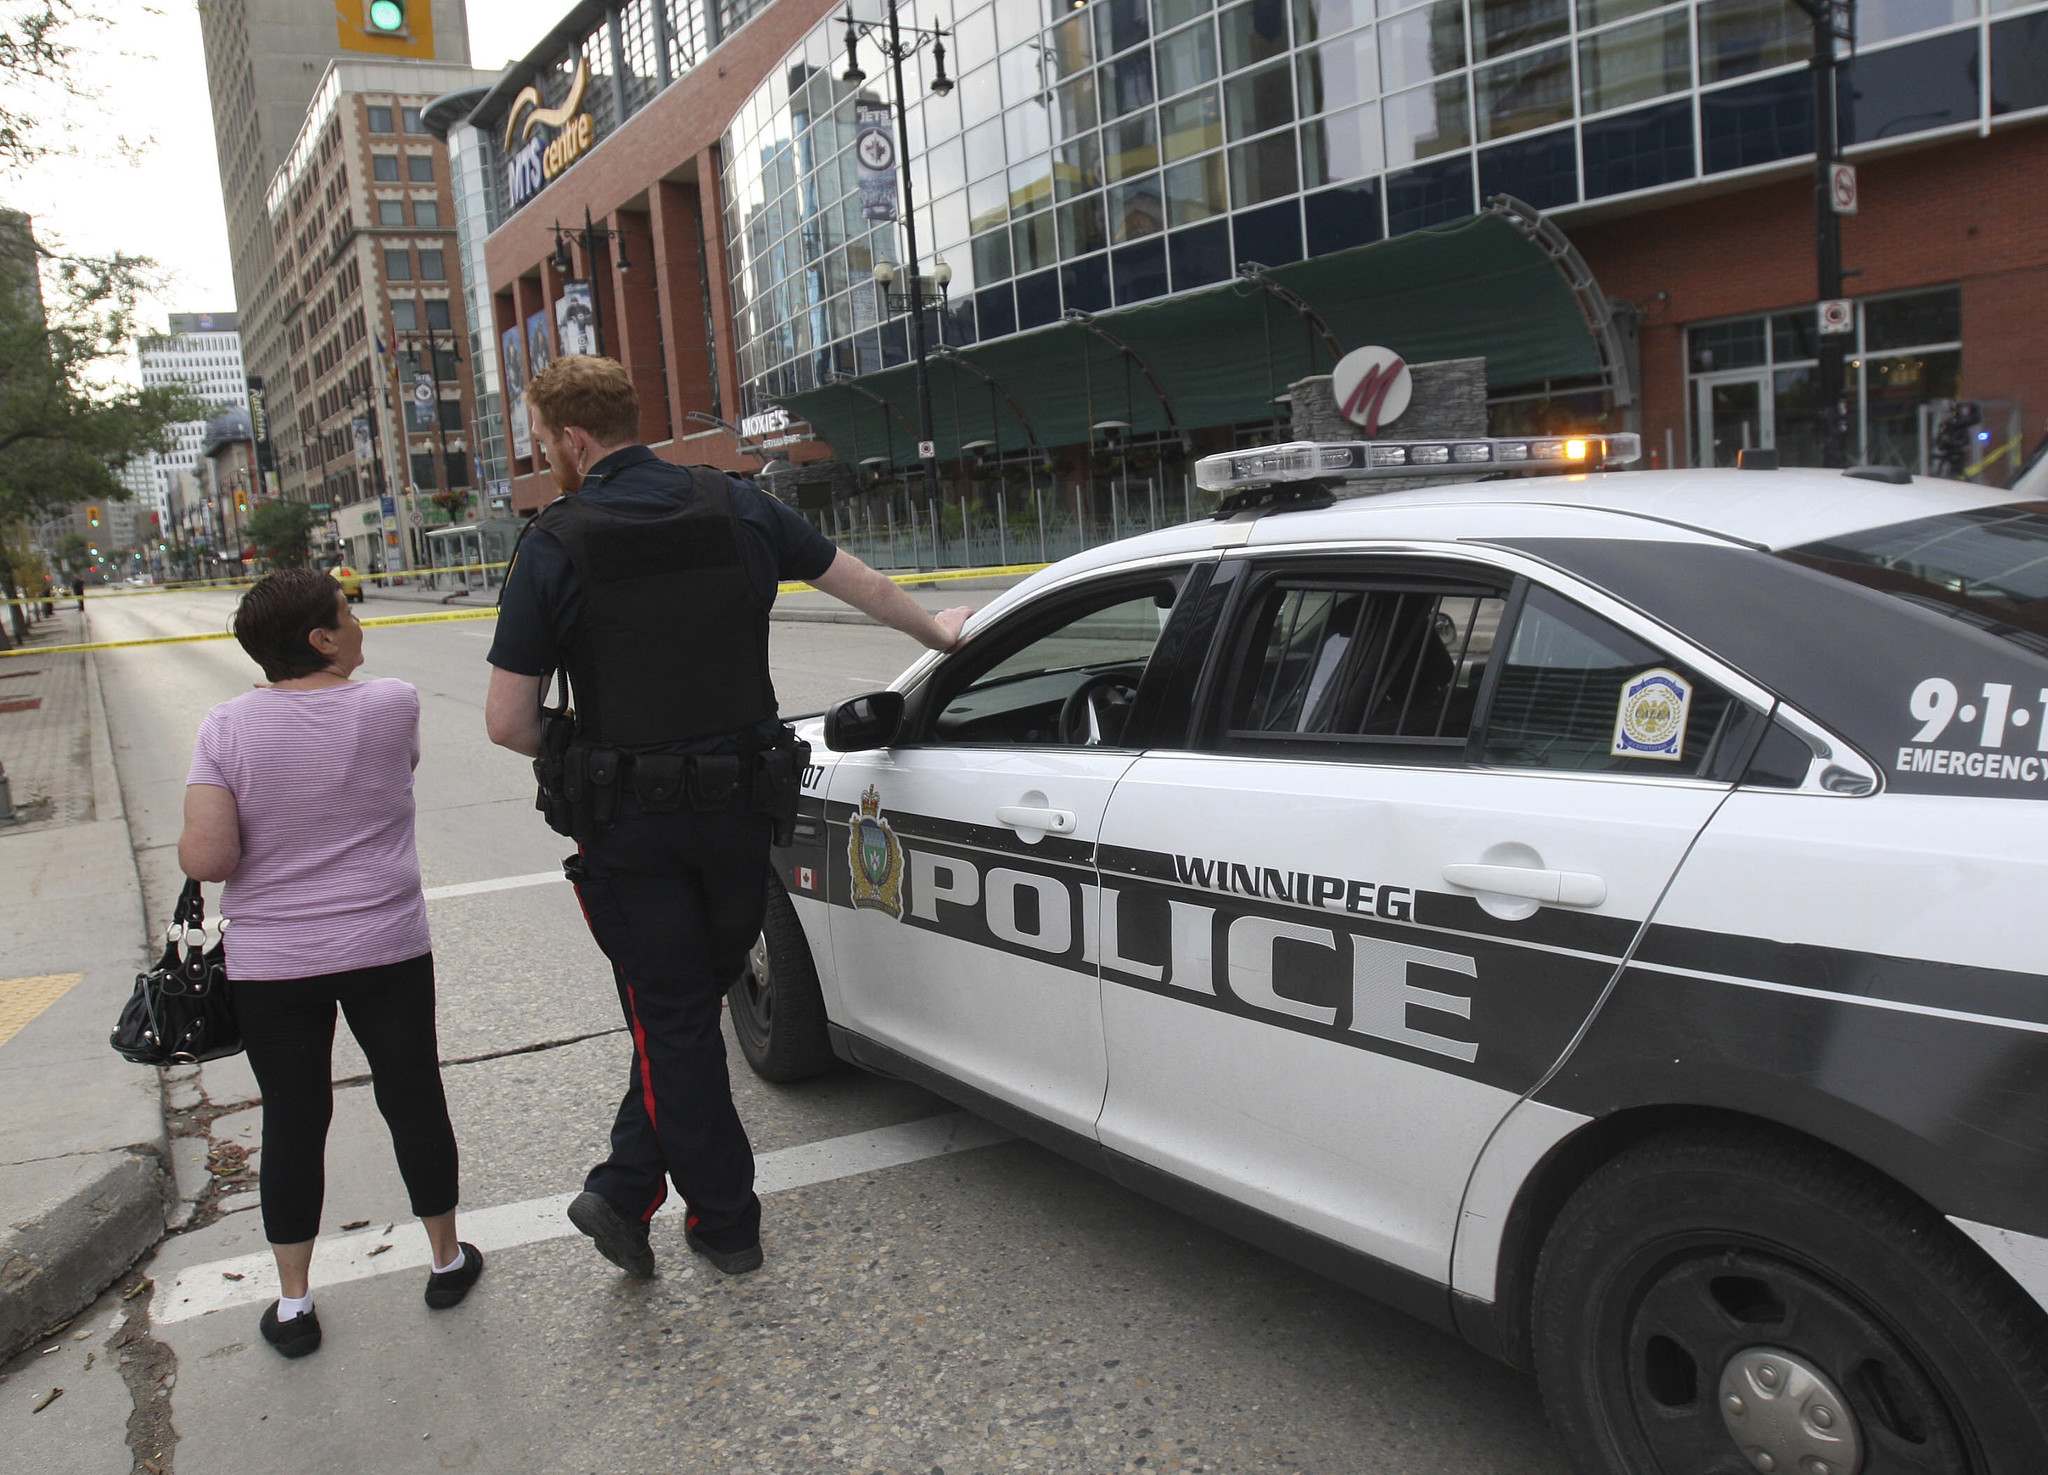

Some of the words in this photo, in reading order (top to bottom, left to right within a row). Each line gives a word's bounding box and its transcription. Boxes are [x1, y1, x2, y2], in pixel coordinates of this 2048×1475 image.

[860, 110, 889, 123] JETS
[508, 136, 543, 209] MTS
[542, 112, 593, 180] centre
[742, 409, 789, 438] MOXIE'S
[1174, 853, 1413, 923] WINNIPEG
[909, 848, 1479, 1063] POLICE
